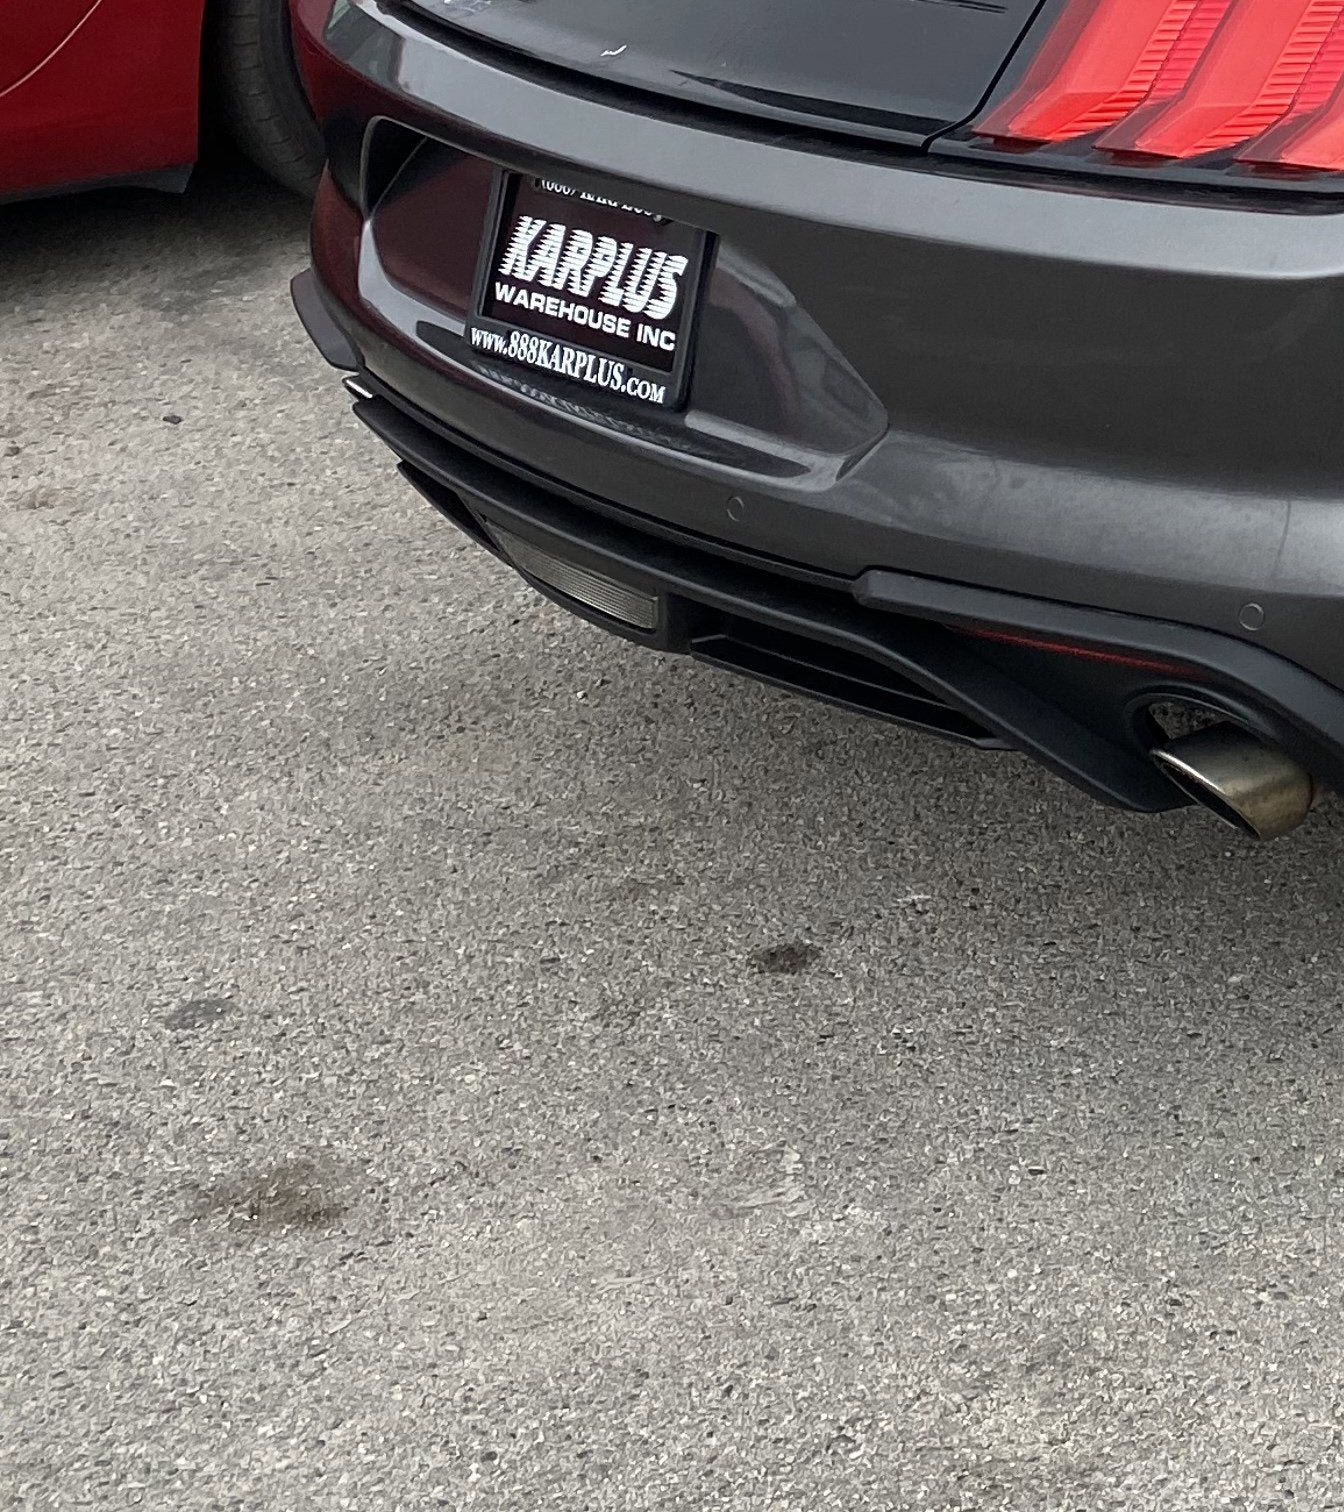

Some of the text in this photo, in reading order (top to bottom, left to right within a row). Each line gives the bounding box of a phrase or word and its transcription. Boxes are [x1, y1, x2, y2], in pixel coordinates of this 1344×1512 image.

[498, 215, 688, 320] KARPLUS
[495, 282, 676, 352] WAREHOUSE INC
